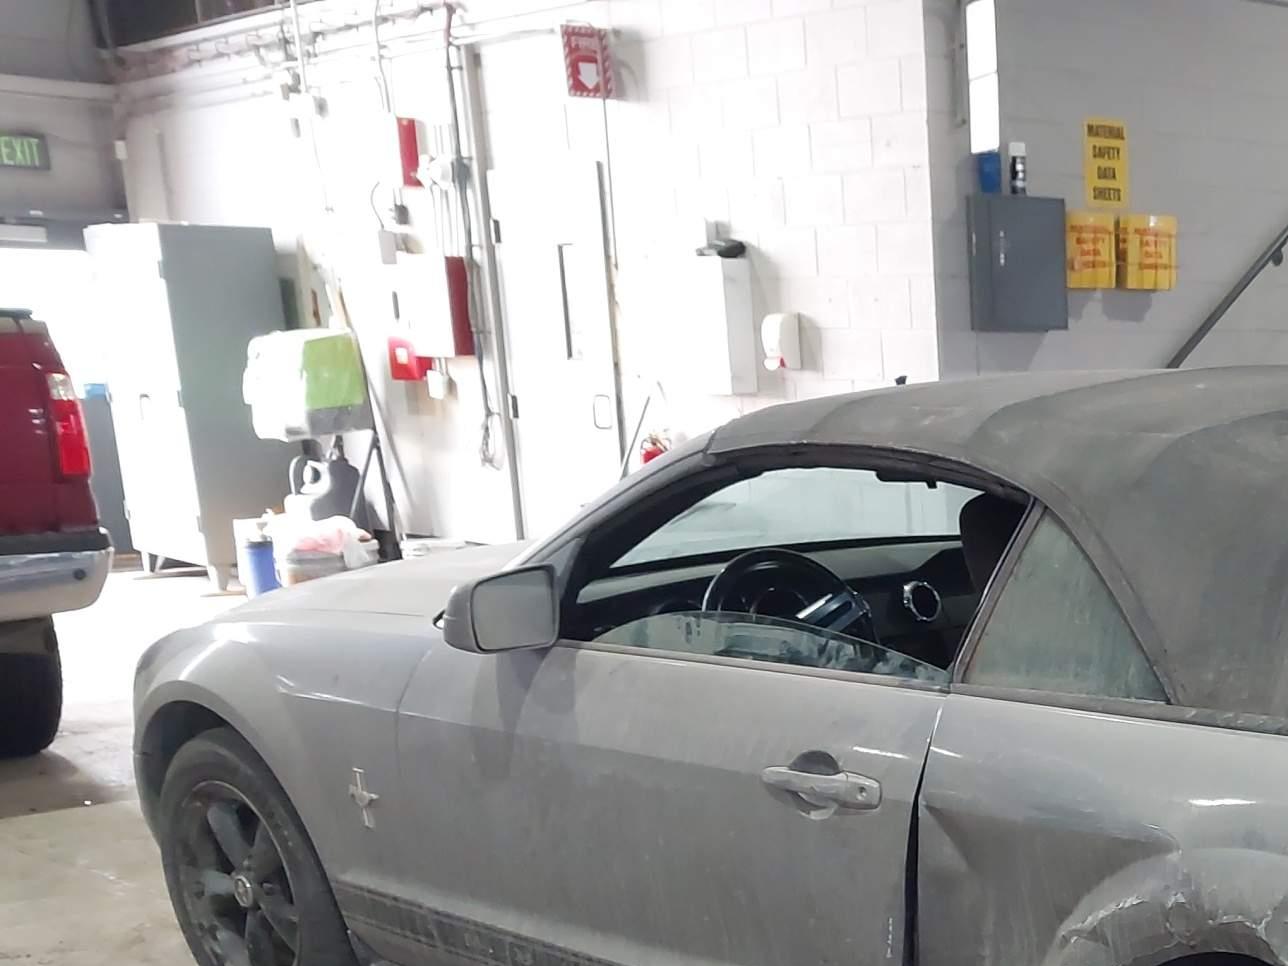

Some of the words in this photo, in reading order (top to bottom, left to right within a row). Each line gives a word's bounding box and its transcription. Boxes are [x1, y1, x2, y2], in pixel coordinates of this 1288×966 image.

[1087, 124, 1125, 140] MATERIAL
[0, 135, 39, 166] EXIT
[1093, 145, 1120, 160] SAFETY
[1097, 166, 1116, 180] DATA
[1093, 186, 1121, 202] SHEETS
